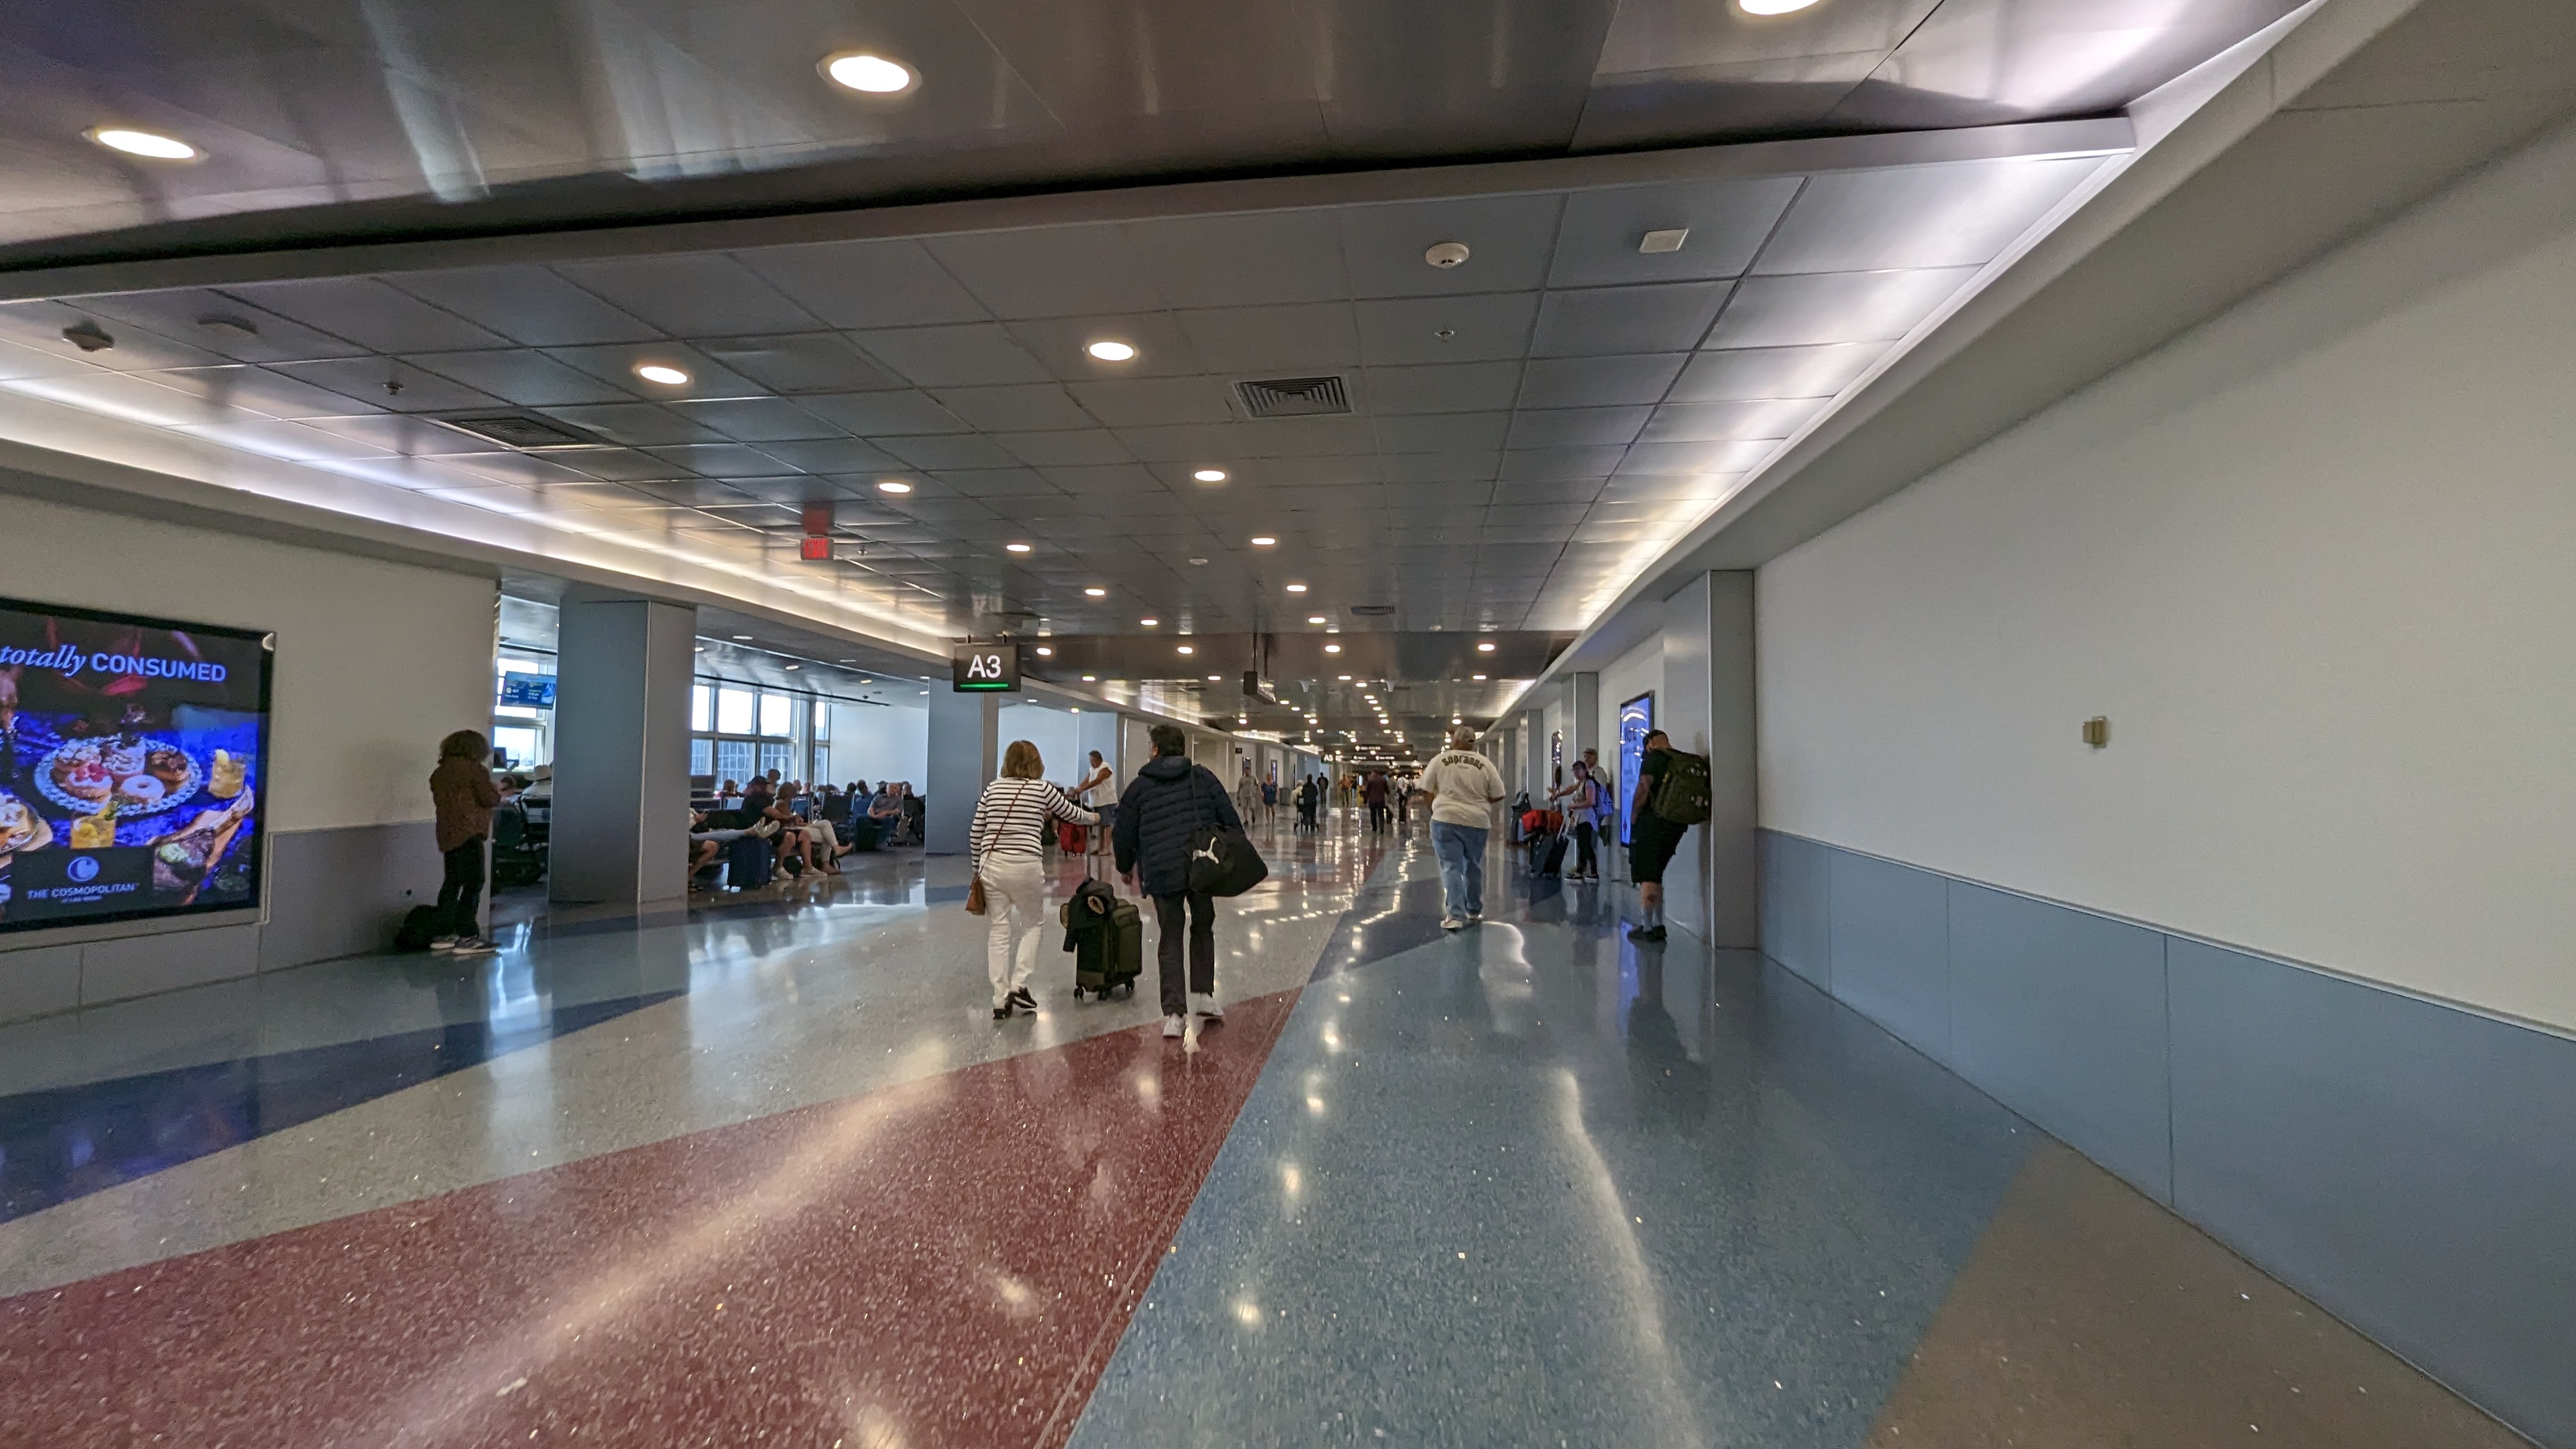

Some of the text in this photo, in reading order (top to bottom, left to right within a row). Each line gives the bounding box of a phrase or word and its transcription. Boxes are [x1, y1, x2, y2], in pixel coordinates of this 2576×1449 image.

[0, 643, 227, 682] totally CONSUMED
[967, 654, 1001, 678] A3
[27, 889, 49, 900] THE
[51, 883, 135, 898] COSMOPOLITAN
